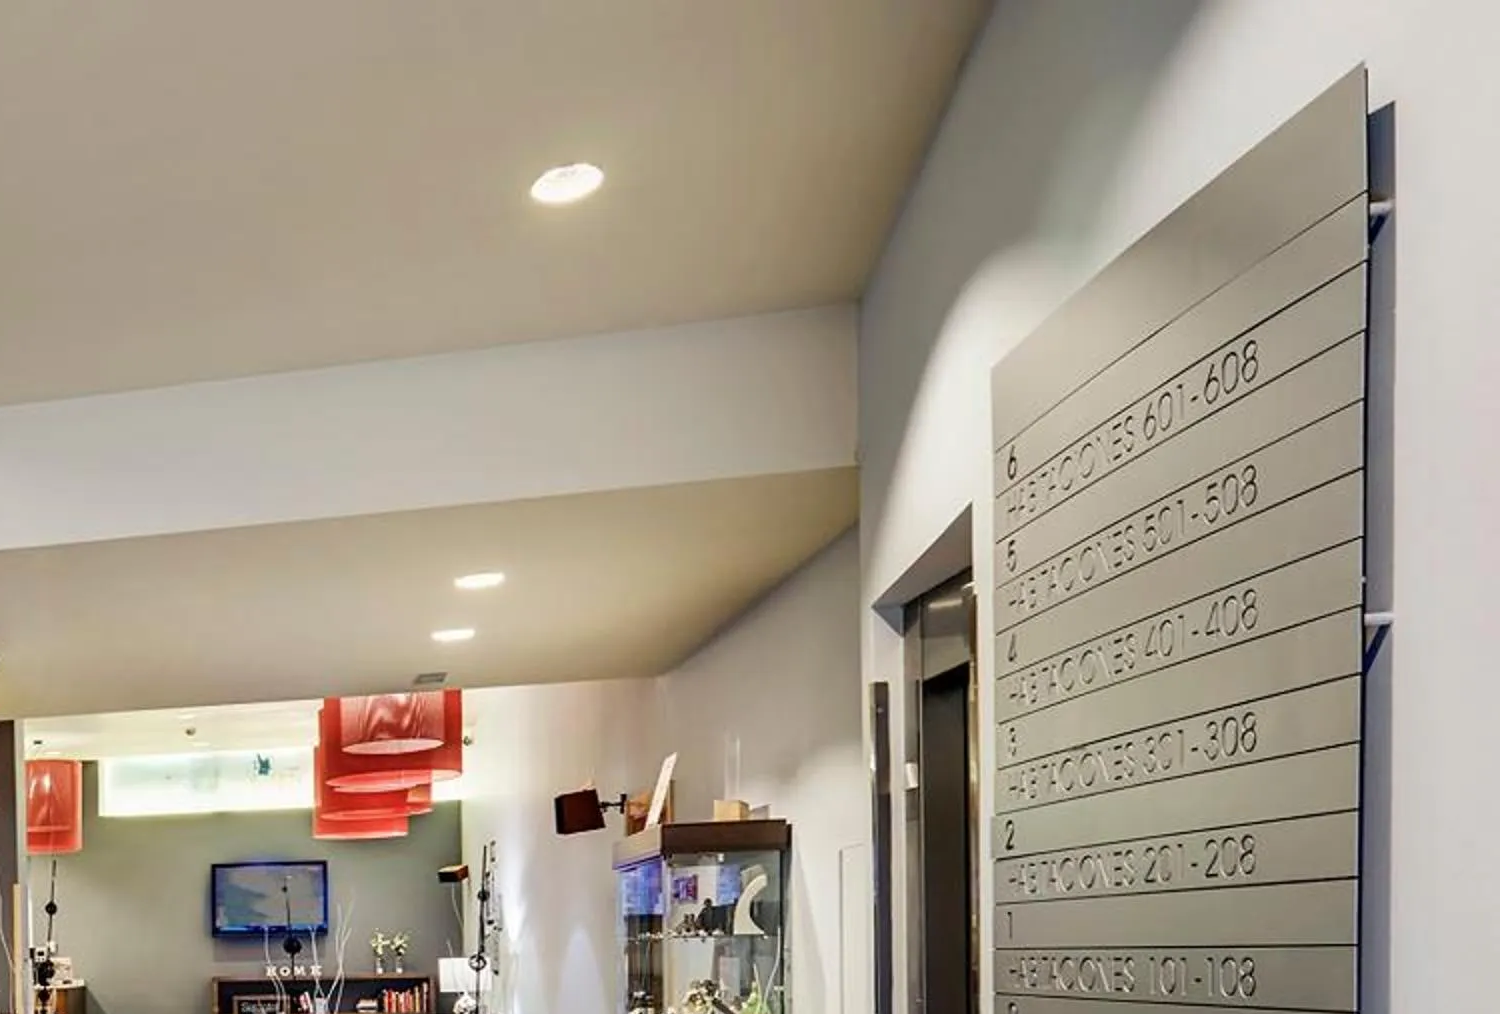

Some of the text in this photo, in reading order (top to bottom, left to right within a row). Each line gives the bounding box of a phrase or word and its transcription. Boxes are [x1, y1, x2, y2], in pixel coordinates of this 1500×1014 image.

[1006, 339, 1259, 519] ABTACONES 601-608
[1007, 444, 1018, 480] 6
[1006, 464, 1259, 616] ABTACONES 501-508
[1006, 539, 1018, 573] 5
[1007, 588, 1259, 709] ABTACONES 401-408
[1007, 711, 1258, 802] ABTACONES 301-308
[1005, 819, 1016, 850] 2
[1007, 834, 1258, 895] ABTACONES 201-208
[1007, 910, 1014, 940] 1
[1007, 955, 1258, 999] ABTACONES 101-108
